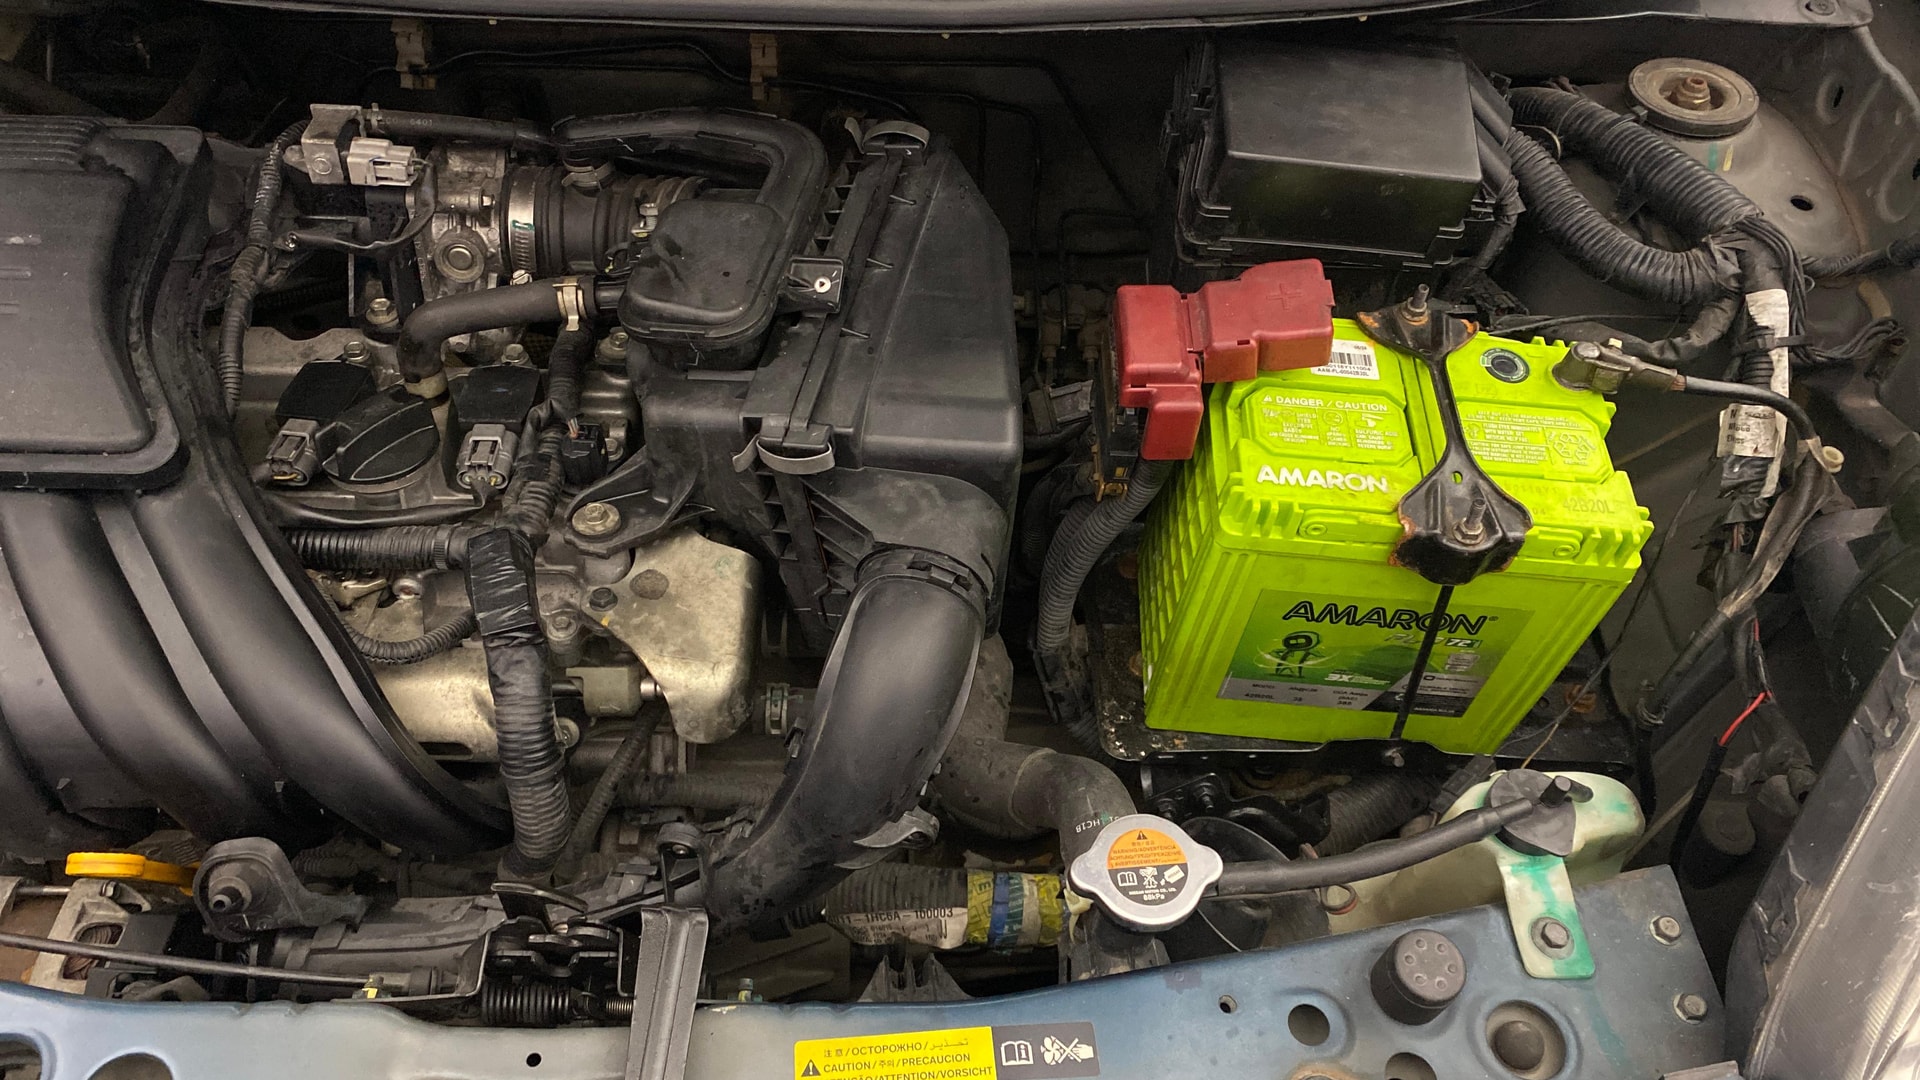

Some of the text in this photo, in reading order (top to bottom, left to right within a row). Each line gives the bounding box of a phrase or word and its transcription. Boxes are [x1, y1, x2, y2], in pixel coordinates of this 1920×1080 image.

[1275, 395, 1324, 407] DANGER
[1335, 401, 1388, 412] CAUTION
[1257, 464, 1388, 494] AMARON
[1562, 497, 1616, 515] 42B20L
[1282, 600, 1488, 635] AMARON
[823, 1061, 872, 1074] CAUTION
[902, 1053, 971, 1067] PRECAUCION
